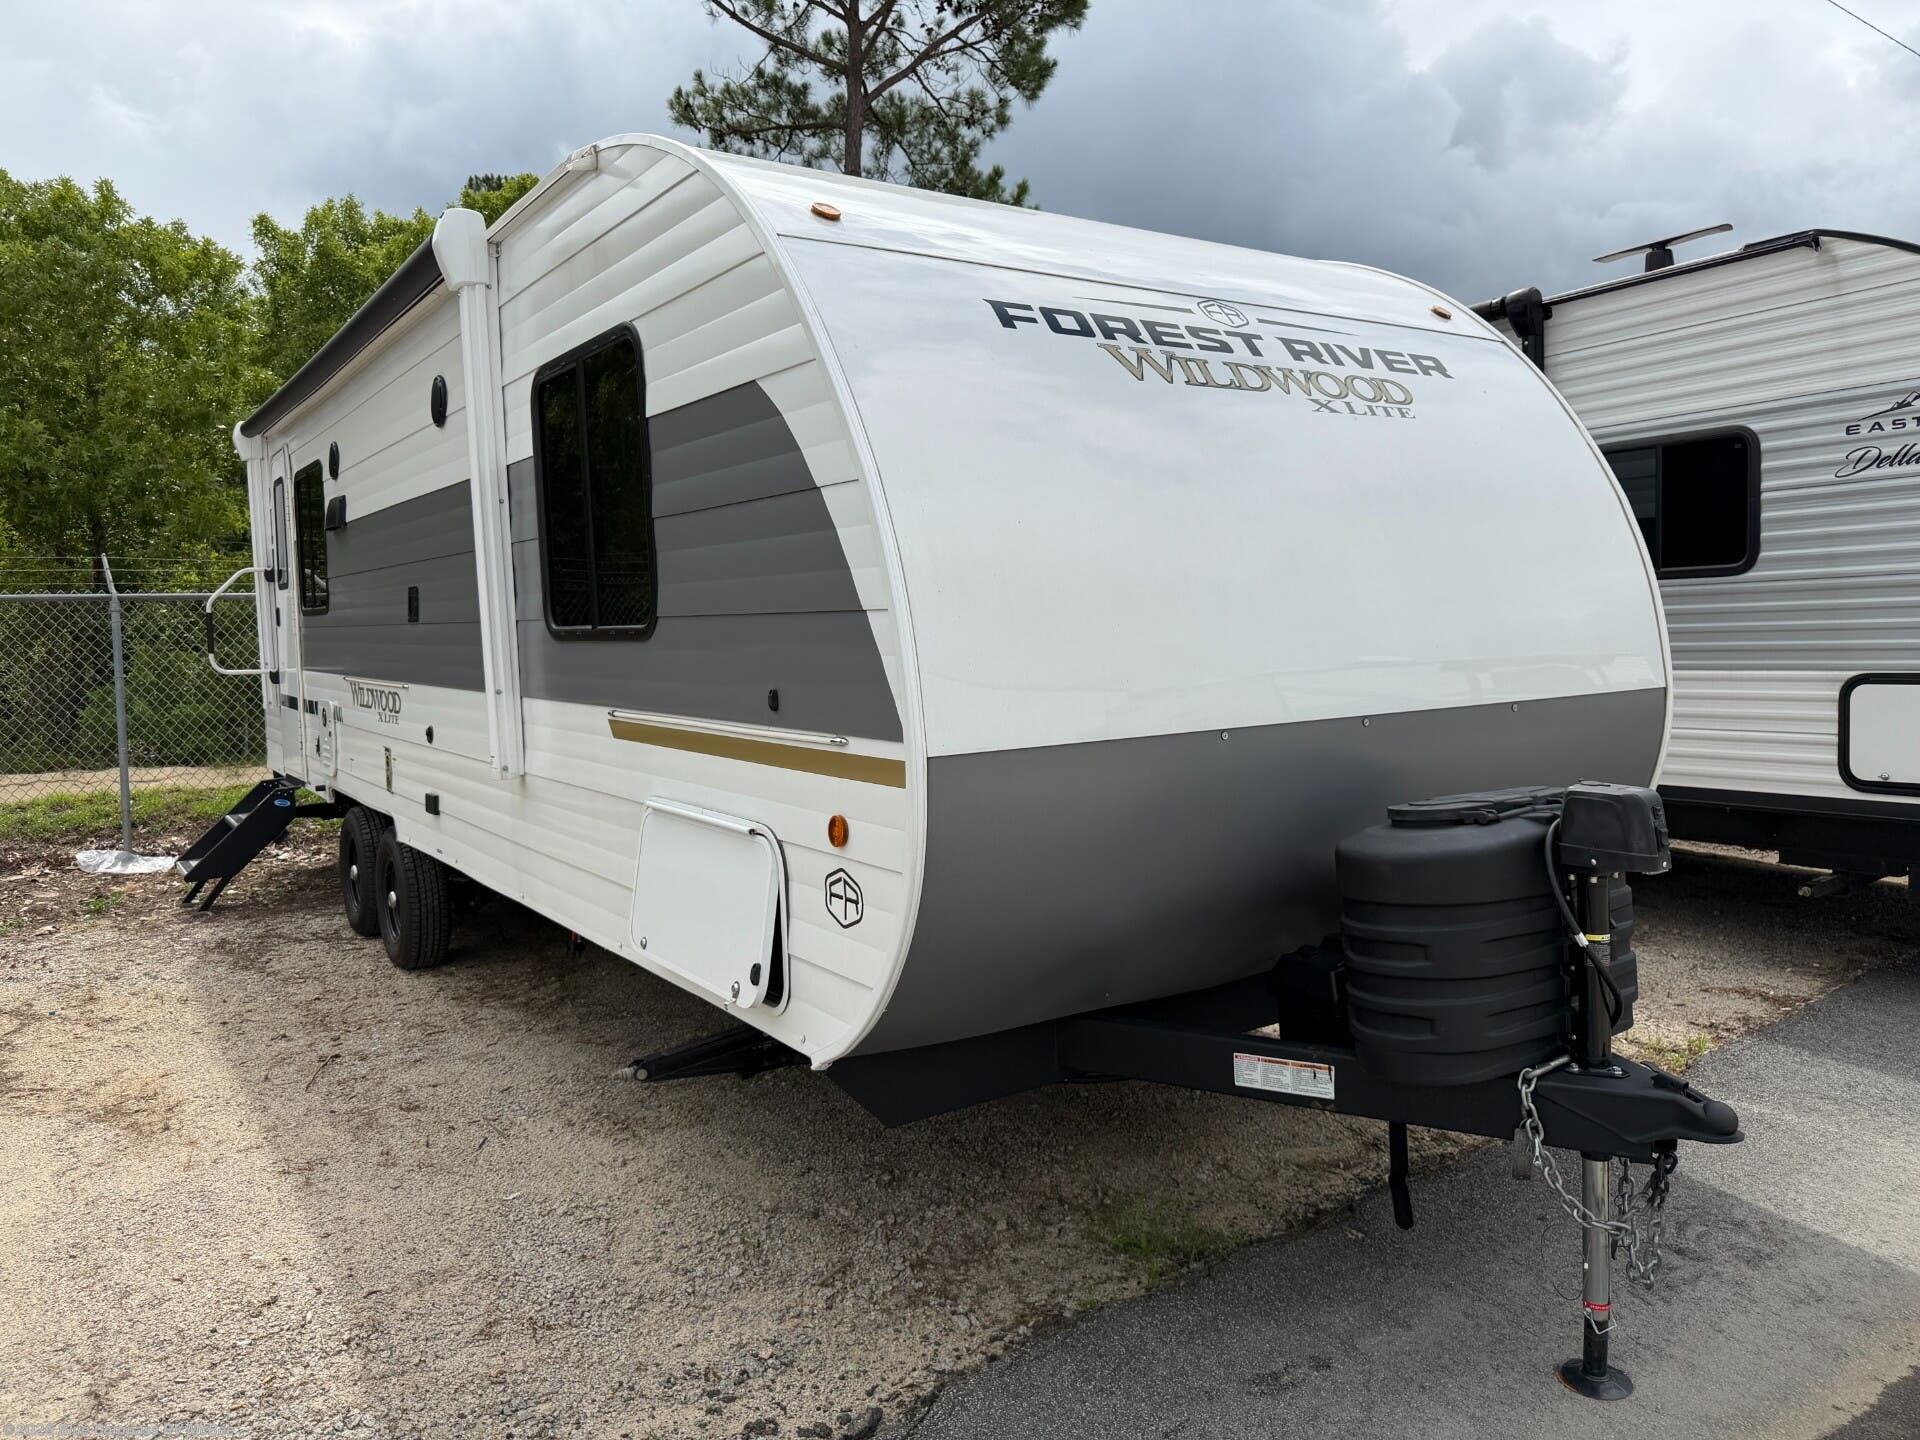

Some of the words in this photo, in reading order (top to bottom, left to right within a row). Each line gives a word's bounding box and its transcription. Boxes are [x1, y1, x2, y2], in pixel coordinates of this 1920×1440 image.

[982, 298, 1264, 358] FOREST
[1274, 336, 1455, 379] RIVER
[1096, 342, 1414, 406] WILDWOOD
[349, 681, 402, 714] WILDWOOD
